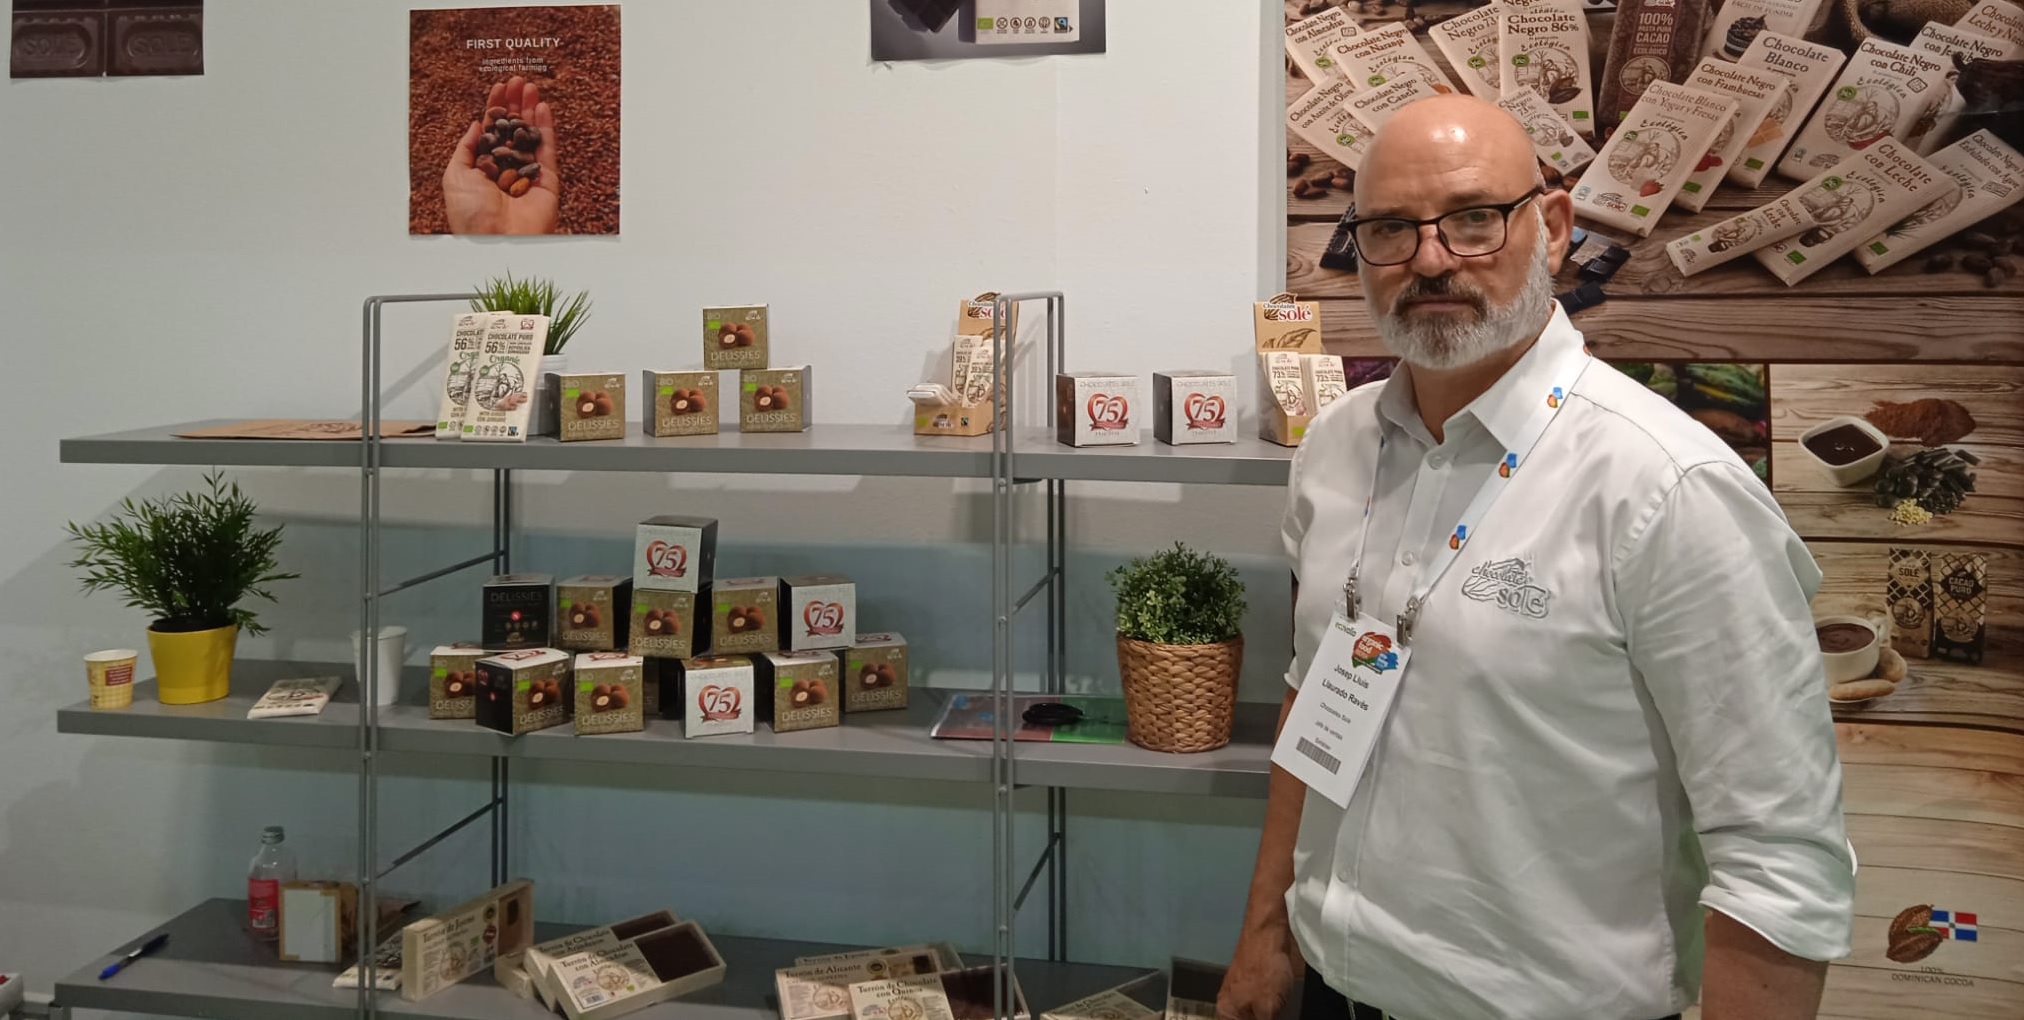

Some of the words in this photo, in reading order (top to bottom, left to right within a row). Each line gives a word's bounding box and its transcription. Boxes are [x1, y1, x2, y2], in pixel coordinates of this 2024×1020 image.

[1285, 17, 1321, 36] Chocolate
[1319, 11, 1341, 23] Negro
[1441, 6, 1500, 32] Chocolate
[1508, 14, 1576, 24] Chocolate
[1639, 13, 1673, 25] 100%
[1968, 14, 1997, 33] Leche
[1295, 35, 1307, 44] con
[1307, 19, 1345, 39] Almendras
[1447, 21, 1485, 41] Negro
[1508, 25, 1548, 36] Negro
[1551, 22, 1579, 32] 86%
[466, 38, 502, 50] FIRST
[505, 37, 560, 48] QUALITY
[1337, 34, 1381, 54] Chocolate
[1380, 28, 1409, 40] Negro
[1636, 33, 1670, 44] CACAO
[1921, 26, 1970, 48] Chocolate
[1969, 40, 2003, 57] Negro
[1924, 41, 1942, 53] con
[1354, 49, 1371, 59] con
[1370, 38, 1405, 52] Naranja
[1763, 36, 1829, 62] Chocolate
[1861, 42, 1909, 64] Chocolate
[1910, 54, 1942, 72] Negro
[478, 64, 517, 72] ecological
[518, 63, 548, 73] farming
[482, 57, 523, 65] ingredients
[526, 56, 544, 64] from
[1764, 52, 1809, 72] Blanco
[1870, 59, 1888, 69] con
[1889, 61, 1919, 77] Chili
[1701, 63, 1746, 83] Chocolate
[1746, 75, 1776, 91] Negro
[1354, 90, 1393, 109] Chocolate
[1390, 79, 1417, 92] Negro
[1697, 76, 1713, 85] con
[1714, 78, 1765, 99] Frambuesas
[1290, 96, 1325, 122] Chocolate
[1319, 82, 1344, 100] Negro
[1372, 103, 1389, 112] con
[1387, 88, 1419, 104] Canela
[1649, 84, 1694, 103] Chocolate
[1694, 95, 1727, 112] Blanco
[1641, 96, 1658, 105] con
[1691, 106, 1720, 122] Fresas
[1302, 118, 1314, 129] con
[1972, 134, 2003, 159] Chocolate
[2000, 154, 2021, 173] Negro
[1864, 153, 1885, 169] con
[1884, 166, 1918, 192] Leche
[1878, 143, 1932, 185] Chocolate
[1763, 207, 1782, 229] Leche
[1279, 306, 1312, 321] solé
[484, 341, 506, 354] 56%
[711, 350, 760, 361] DELISSIES
[659, 378, 673, 386] BIO
[746, 413, 796, 424] DELISSIES
[1096, 400, 1119, 422] 75
[1193, 400, 1216, 421] 75
[568, 420, 620, 431] DELISSIES
[662, 415, 712, 427] DELISSIES
[655, 547, 677, 570] 75
[1949, 577, 1974, 587] CACAO
[1950, 585, 1972, 594] PURO
[812, 607, 835, 628] 75
[635, 637, 686, 649] DELISSIES
[1334, 664, 1353, 680] Josep
[707, 692, 731, 712] 75
[520, 706, 564, 725] DELISSIES
[582, 712, 636, 725] DELISSIES
[782, 708, 832, 721] DELISSIES
[814, 967, 825, 976] de
[826, 963, 861, 974] Alicante
[1921, 966, 1945, 974] 100%
[885, 982, 896, 991] de
[896, 977, 938, 989] Chocolate
[1892, 973, 1942, 984] DOMINICAN
[1944, 977, 1975, 987] COCOA
[876, 991, 891, 999] con
